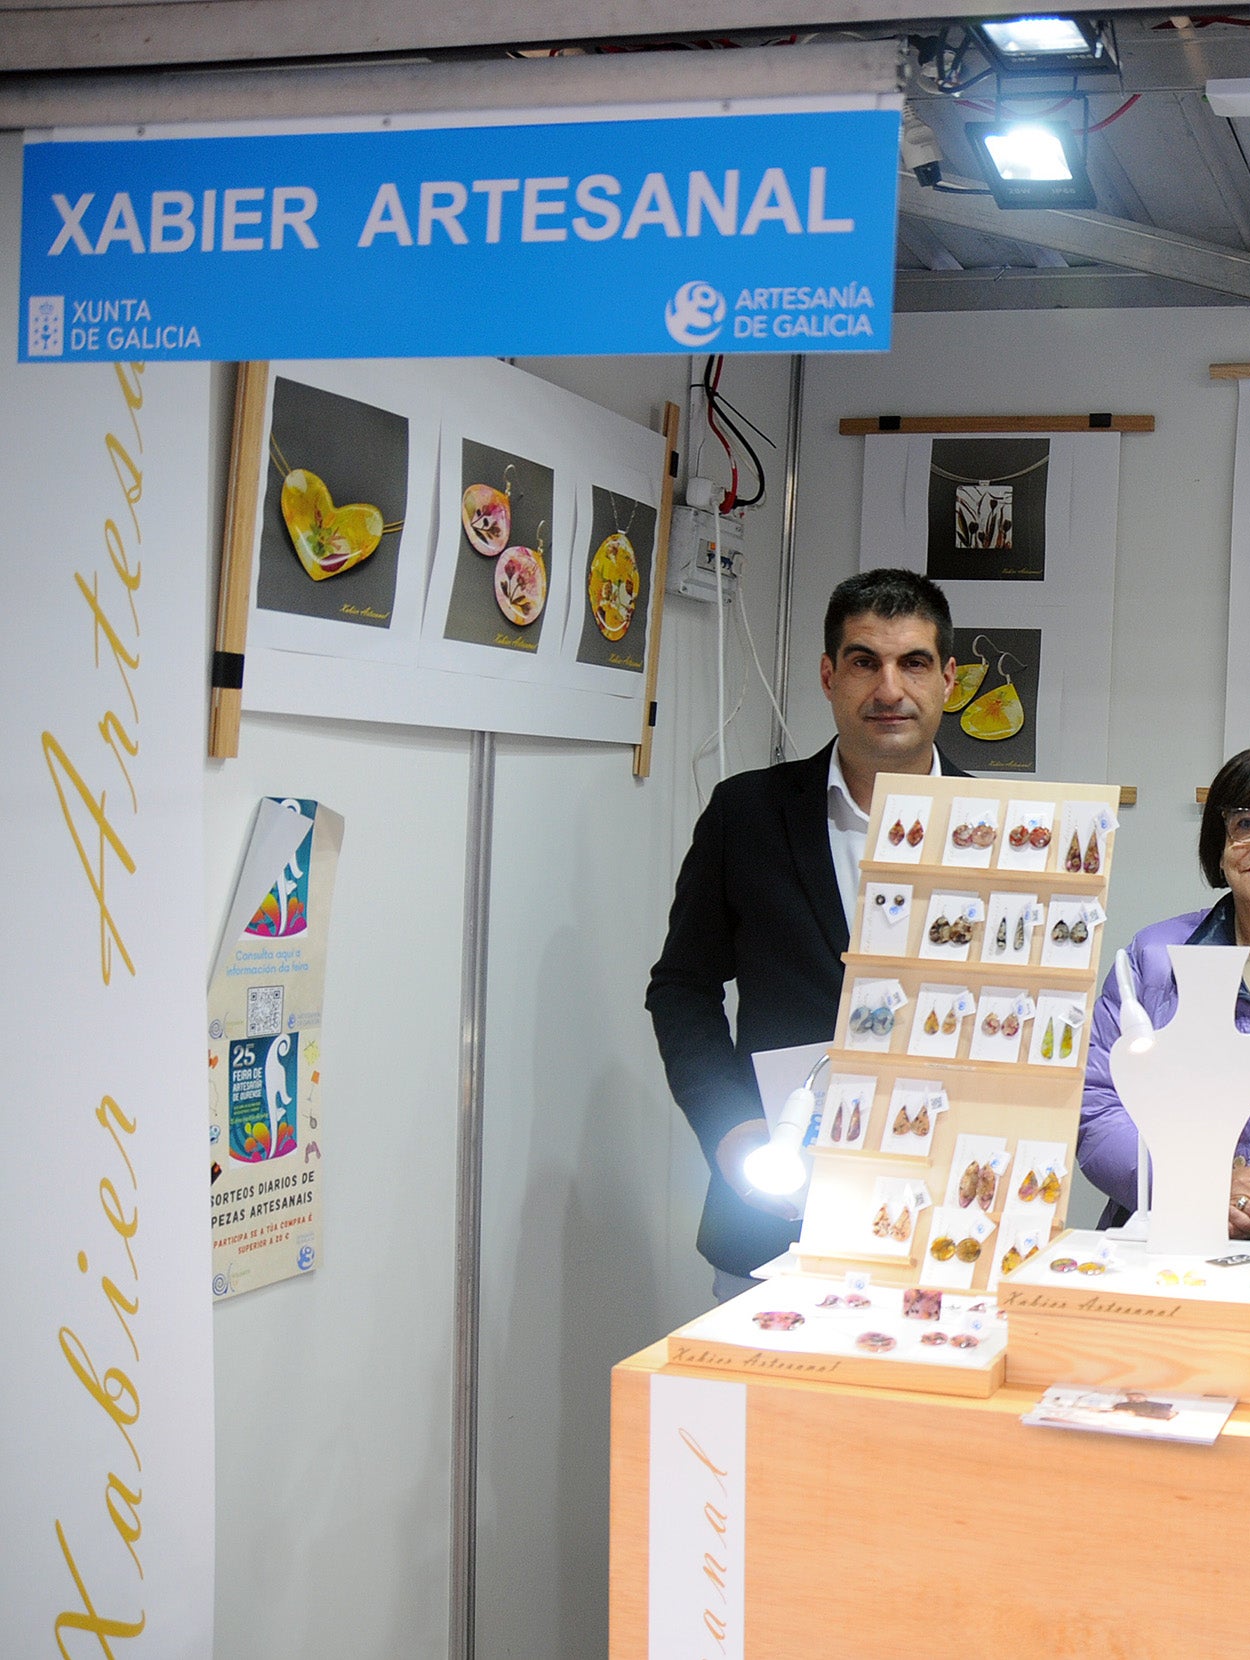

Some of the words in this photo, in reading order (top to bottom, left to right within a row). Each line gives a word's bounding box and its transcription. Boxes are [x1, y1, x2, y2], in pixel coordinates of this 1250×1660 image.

[47, 185, 320, 257] XABIER
[357, 165, 855, 248] ARTESANAL
[735, 281, 875, 310] ARTESANÍA
[72, 299, 152, 323] XUNTA
[71, 328, 99, 350] DE
[107, 326, 201, 350] GALICIA
[734, 315, 767, 338] DE
[773, 313, 874, 338] GALICIA
[232, 1043, 256, 1068] 25
[258, 1174, 298, 1196] DIARIOS
[301, 1170, 315, 1184] DE
[211, 1208, 246, 1229] PEZAS
[249, 1190, 313, 1219] ARTESANAIS
